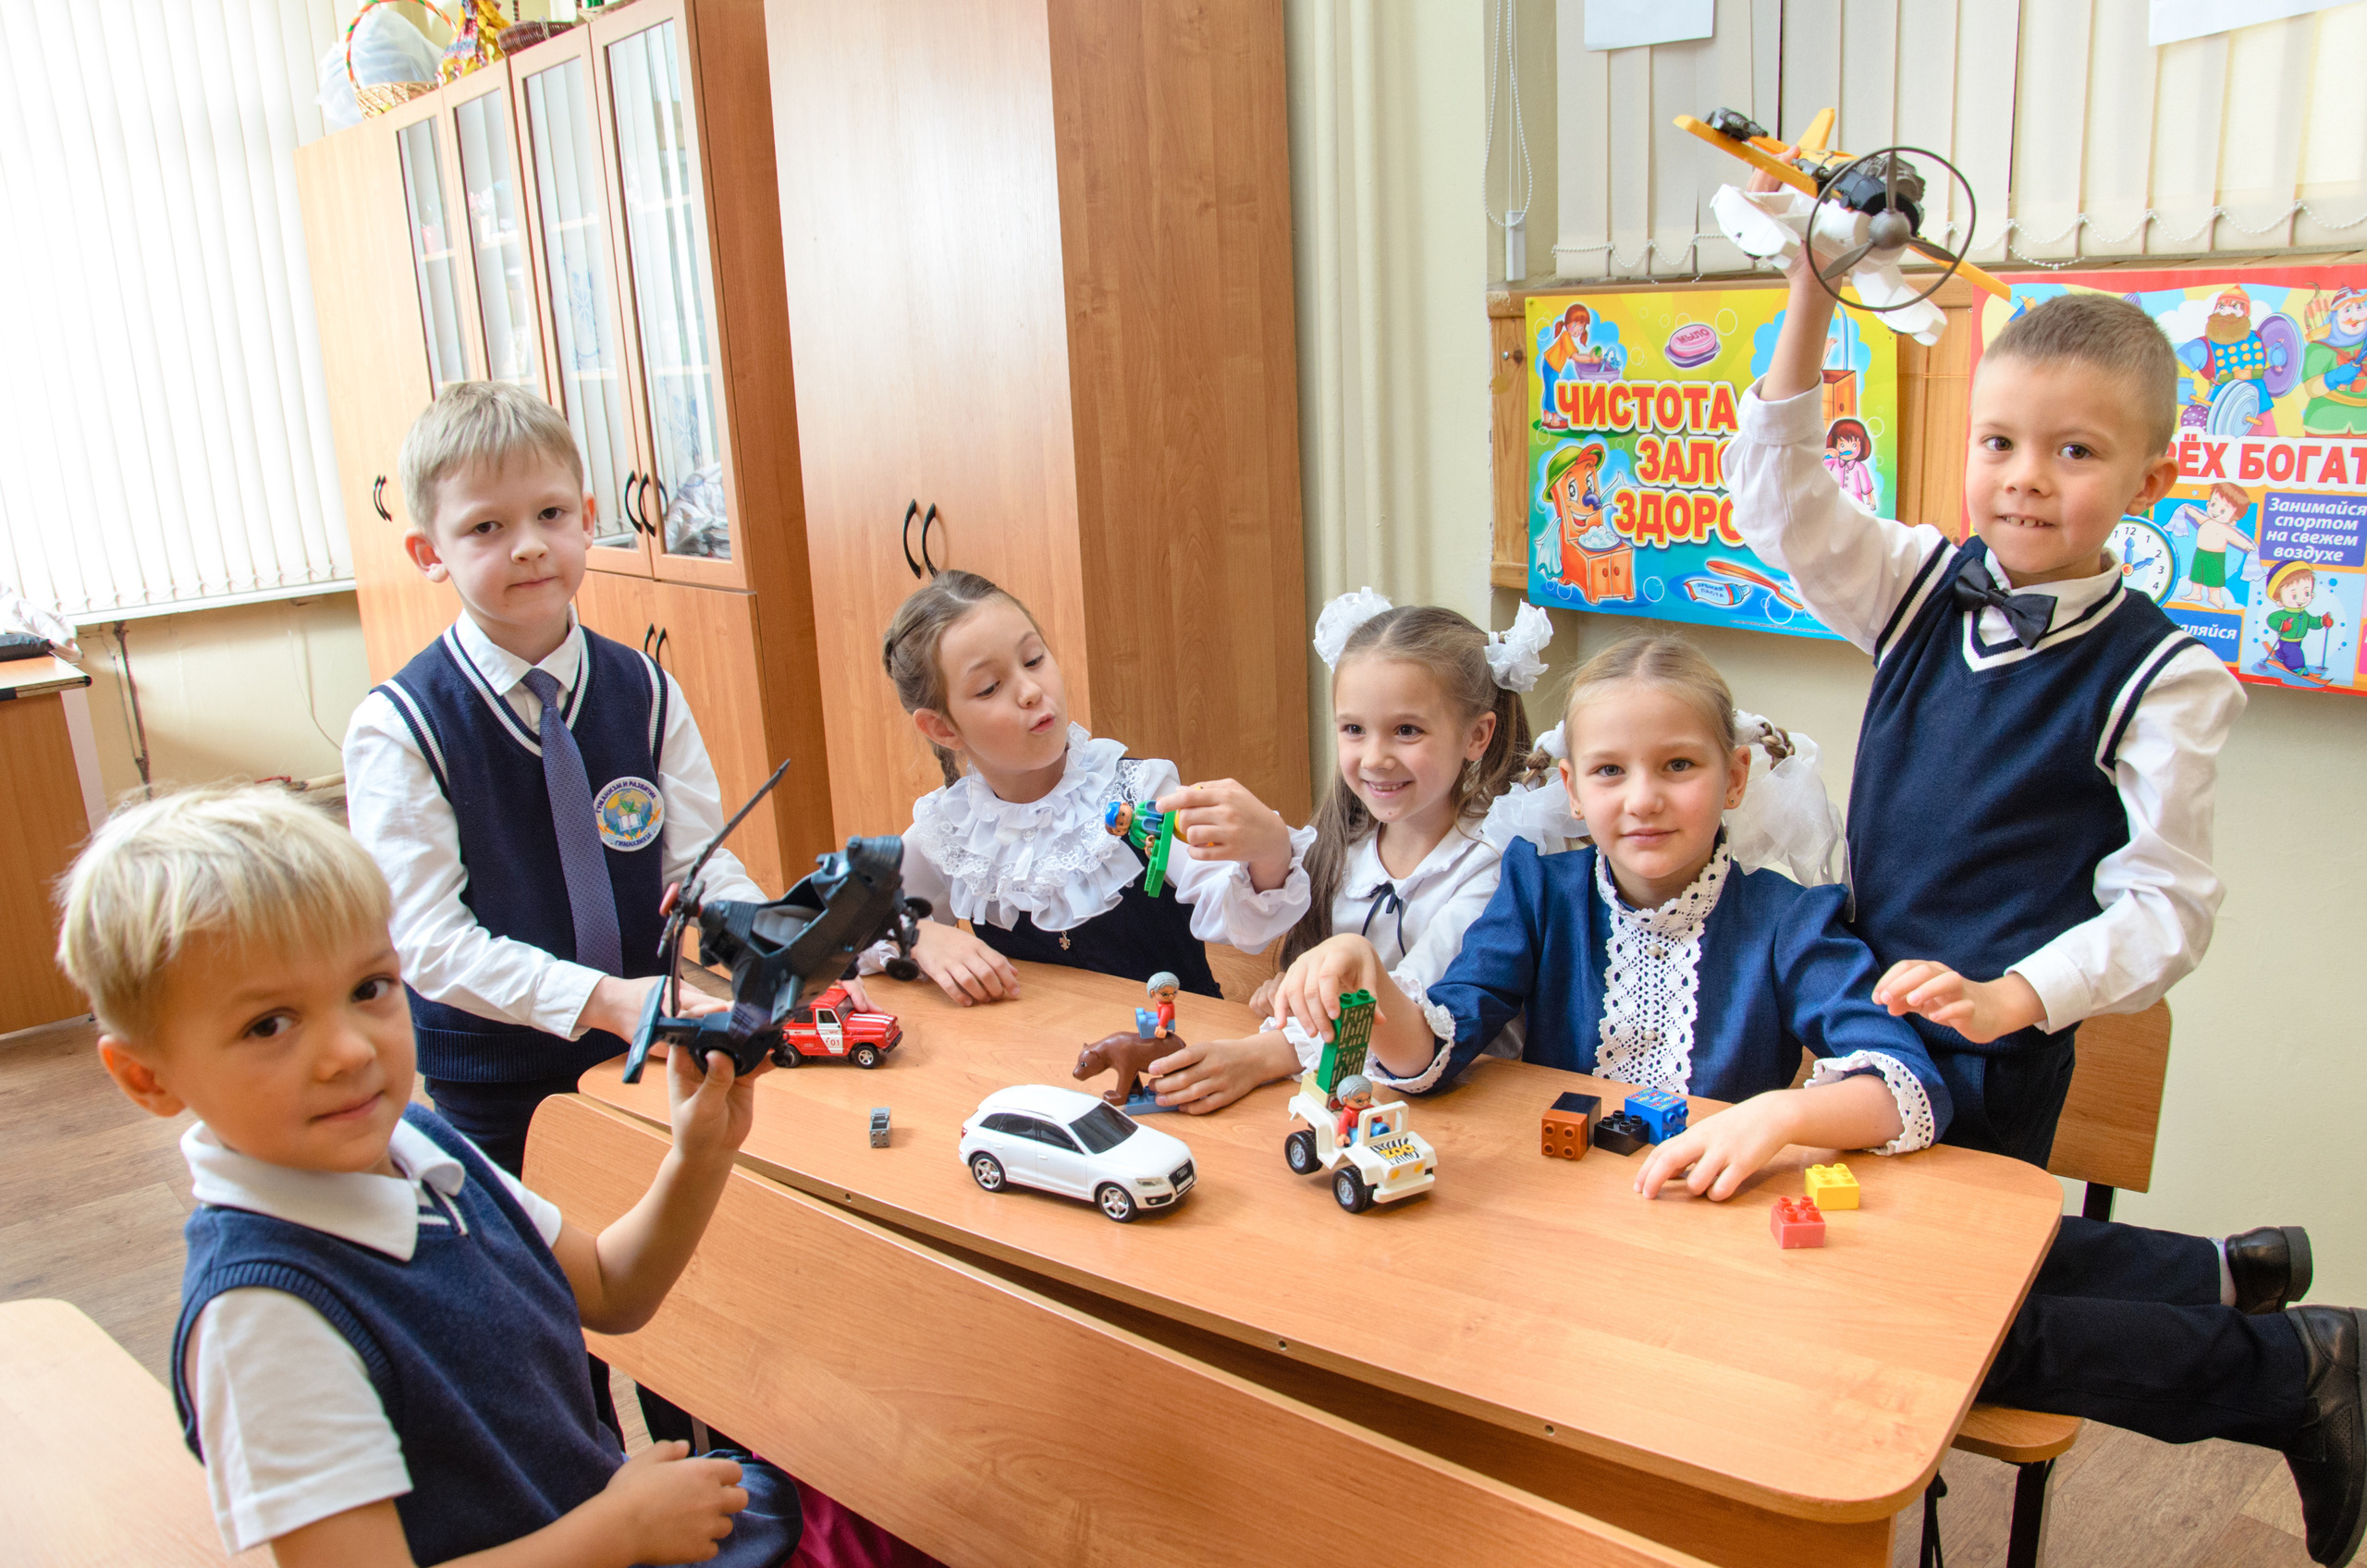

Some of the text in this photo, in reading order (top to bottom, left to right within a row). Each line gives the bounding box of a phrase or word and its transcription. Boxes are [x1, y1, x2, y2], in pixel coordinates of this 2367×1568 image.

[1676, 328, 1710, 344] МЫЛО
[1557, 383, 1739, 431] ЧИСТОТА
[2238, 443, 2367, 484] БОГАТ
[2268, 497, 2367, 516] Занимайся
[2275, 516, 2359, 531] спортом
[2125, 527, 2137, 536] 12
[2265, 531, 2359, 546] на свежем
[2146, 535, 2151, 544] 1
[2154, 549, 2162, 558] 2
[2273, 545, 2344, 563] воздухе
[2157, 565, 2165, 574] 3
[2152, 582, 2159, 590] 4
[629, 780, 656, 800] РАЗВИТИЕ
[1379, 1143, 1416, 1159] ZOO
